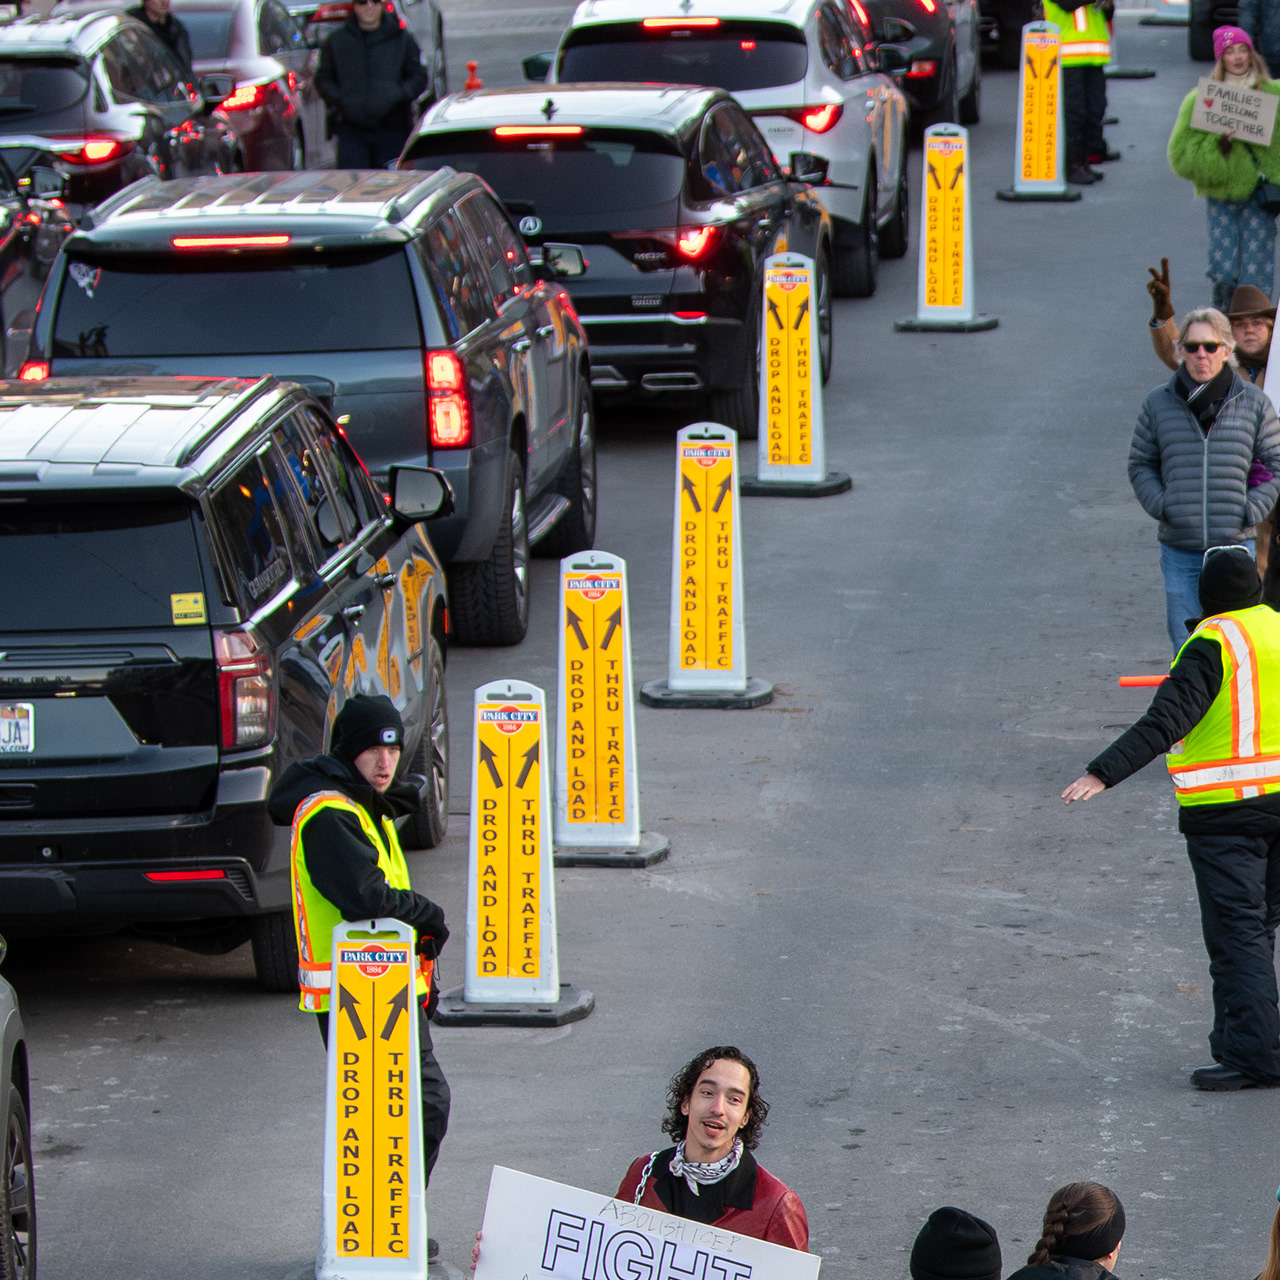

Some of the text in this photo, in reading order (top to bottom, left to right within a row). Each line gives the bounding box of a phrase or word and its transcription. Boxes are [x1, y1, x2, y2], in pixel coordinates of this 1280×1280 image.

[1204, 111, 1264, 137] TOGETHER
[1207, 84, 1262, 108] FAMILIES
[1221, 102, 1259, 121] BELONG
[769, 337, 785, 463] DROP AND LOAD
[796, 337, 808, 463] THRU TRAFFIC
[570, 580, 618, 588] PARK CITY
[683, 521, 697, 666] DROP AND LOAD
[717, 521, 729, 667] THRU TRAFFIC
[483, 711, 536, 720] PARK CITY
[570, 659, 586, 820] DROP AND LOAD
[606, 659, 621, 820] THRU TRAFFIC
[482, 799, 497, 972] DROP AND LOAD
[522, 800, 535, 973] THRU TRAFFIC
[344, 952, 404, 962] PARK CITY
[343, 1053, 359, 1251] DROP AND LOAD
[388, 1053, 404, 1253] THRU TRAFFIC
[598, 1198, 687, 1235] ABOLISH
